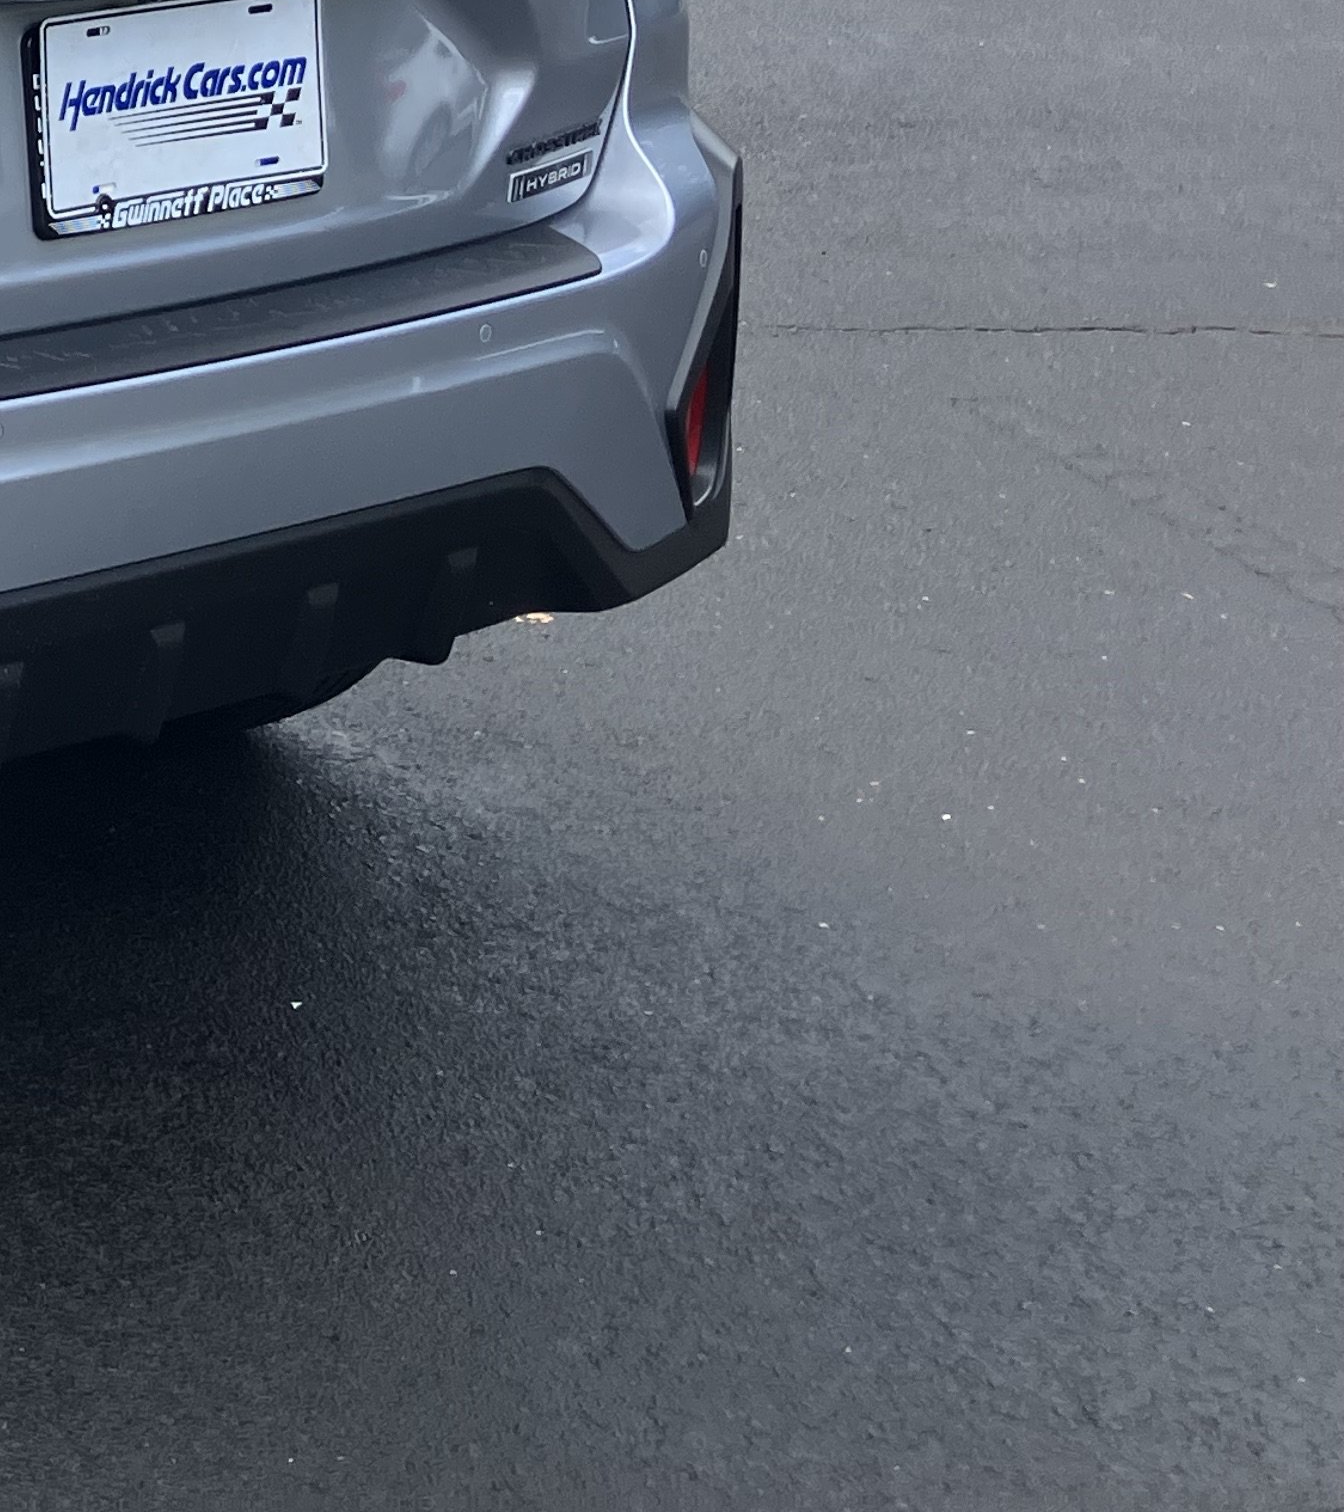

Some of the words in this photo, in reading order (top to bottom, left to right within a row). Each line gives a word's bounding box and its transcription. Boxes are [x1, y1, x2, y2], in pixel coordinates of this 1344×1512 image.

[525, 162, 582, 192] HYBRID
[112, 189, 209, 229] Gwinnett
[209, 183, 265, 213] Place
